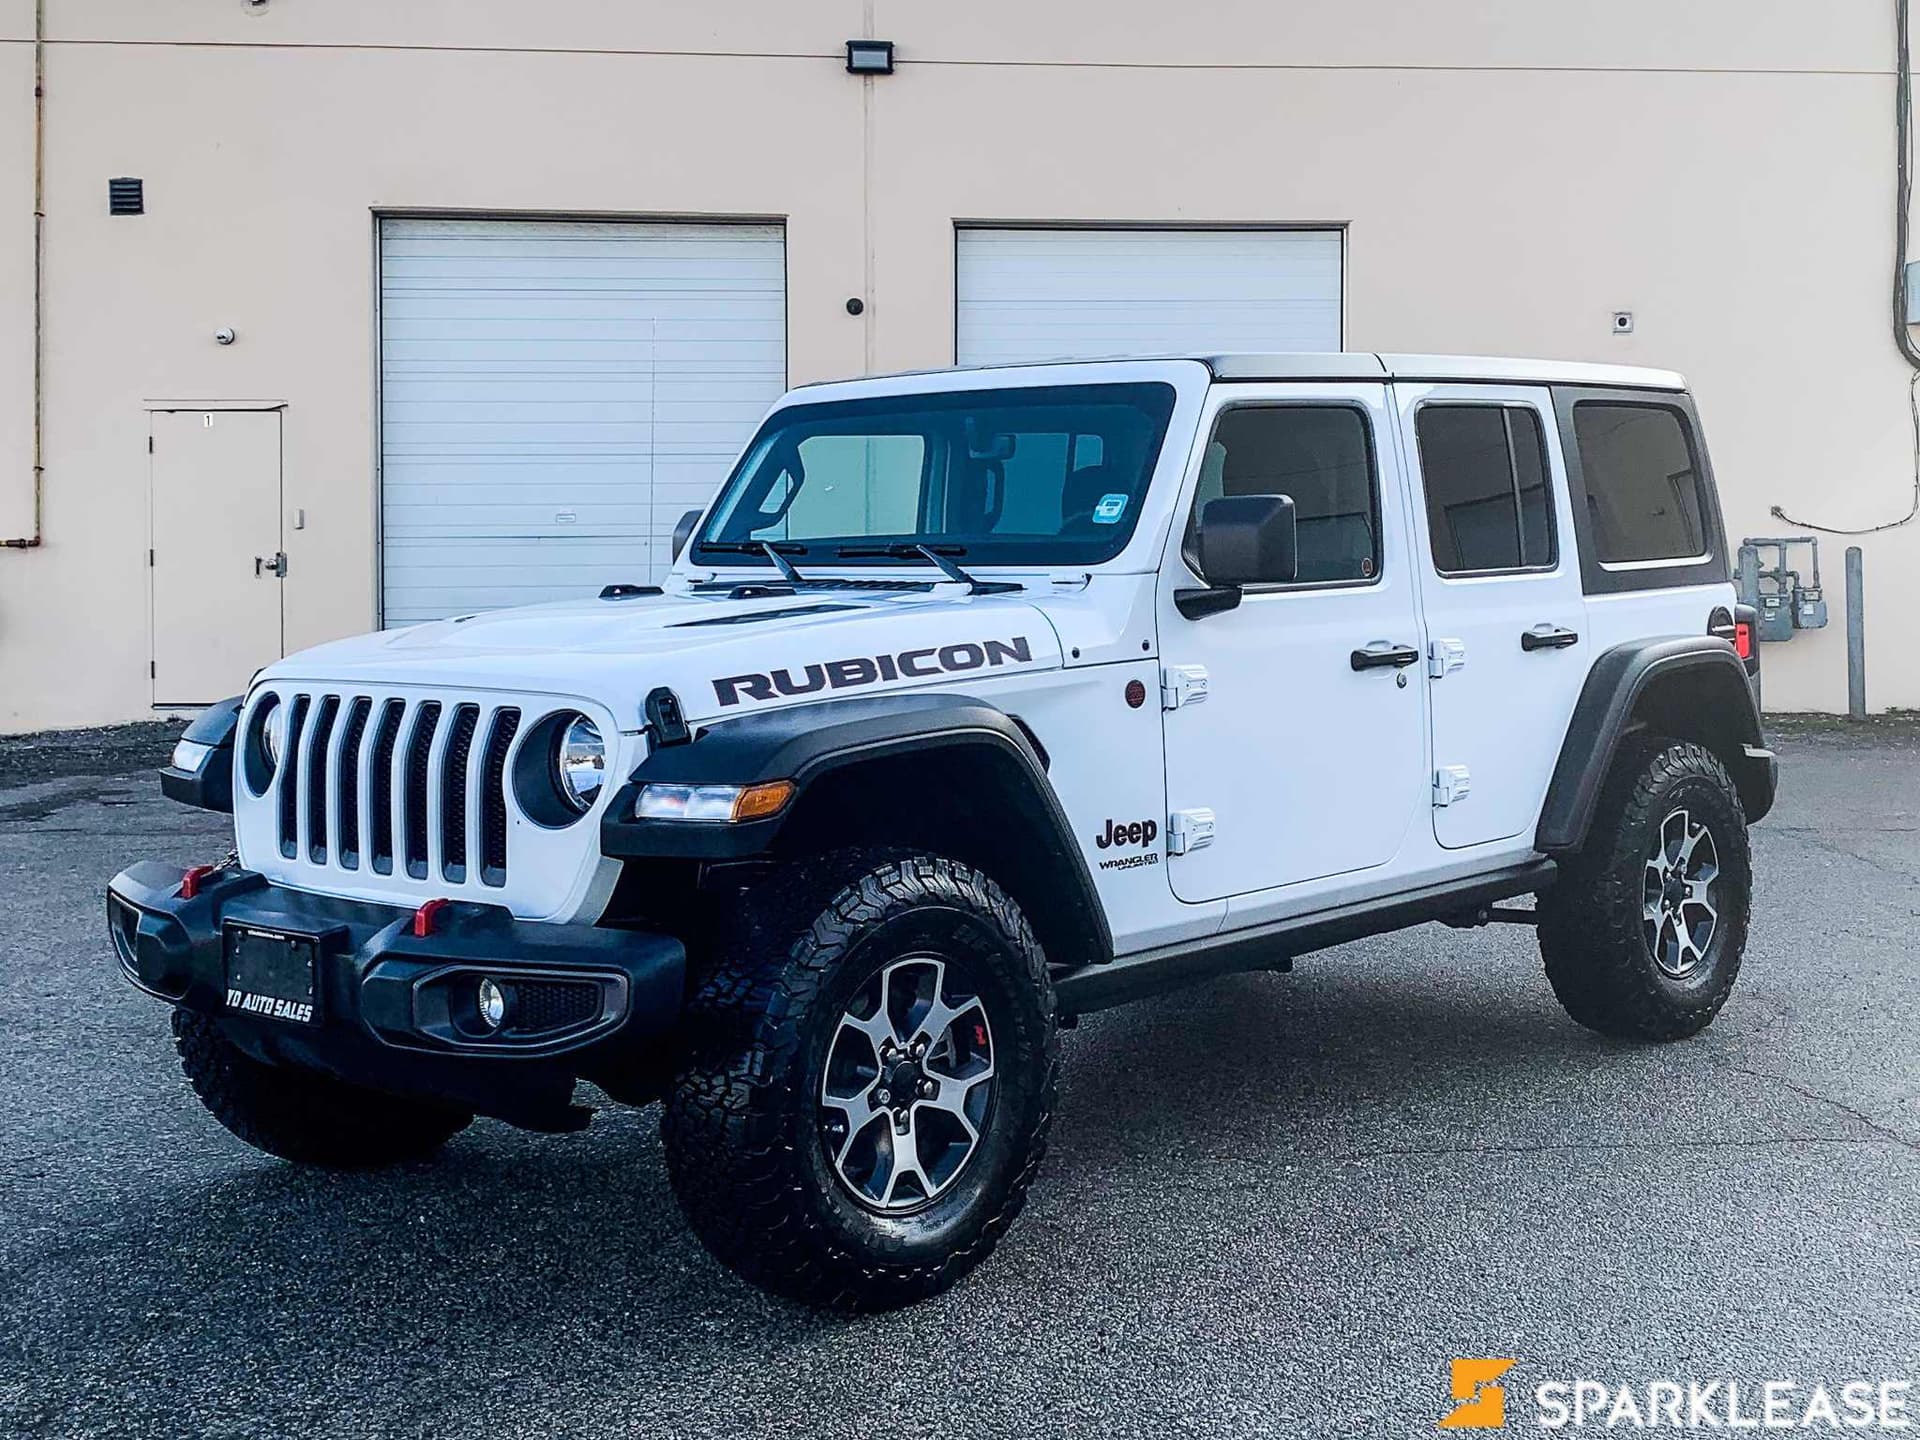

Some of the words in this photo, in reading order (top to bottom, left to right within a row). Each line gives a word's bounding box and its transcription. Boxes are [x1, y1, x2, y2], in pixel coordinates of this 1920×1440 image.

[712, 636, 1032, 707] RUBICON
[1096, 818, 1157, 849] Jeep
[1099, 853, 1158, 870] WRANGLER
[241, 993, 275, 1015] AUTO
[273, 999, 313, 1022] SALES
